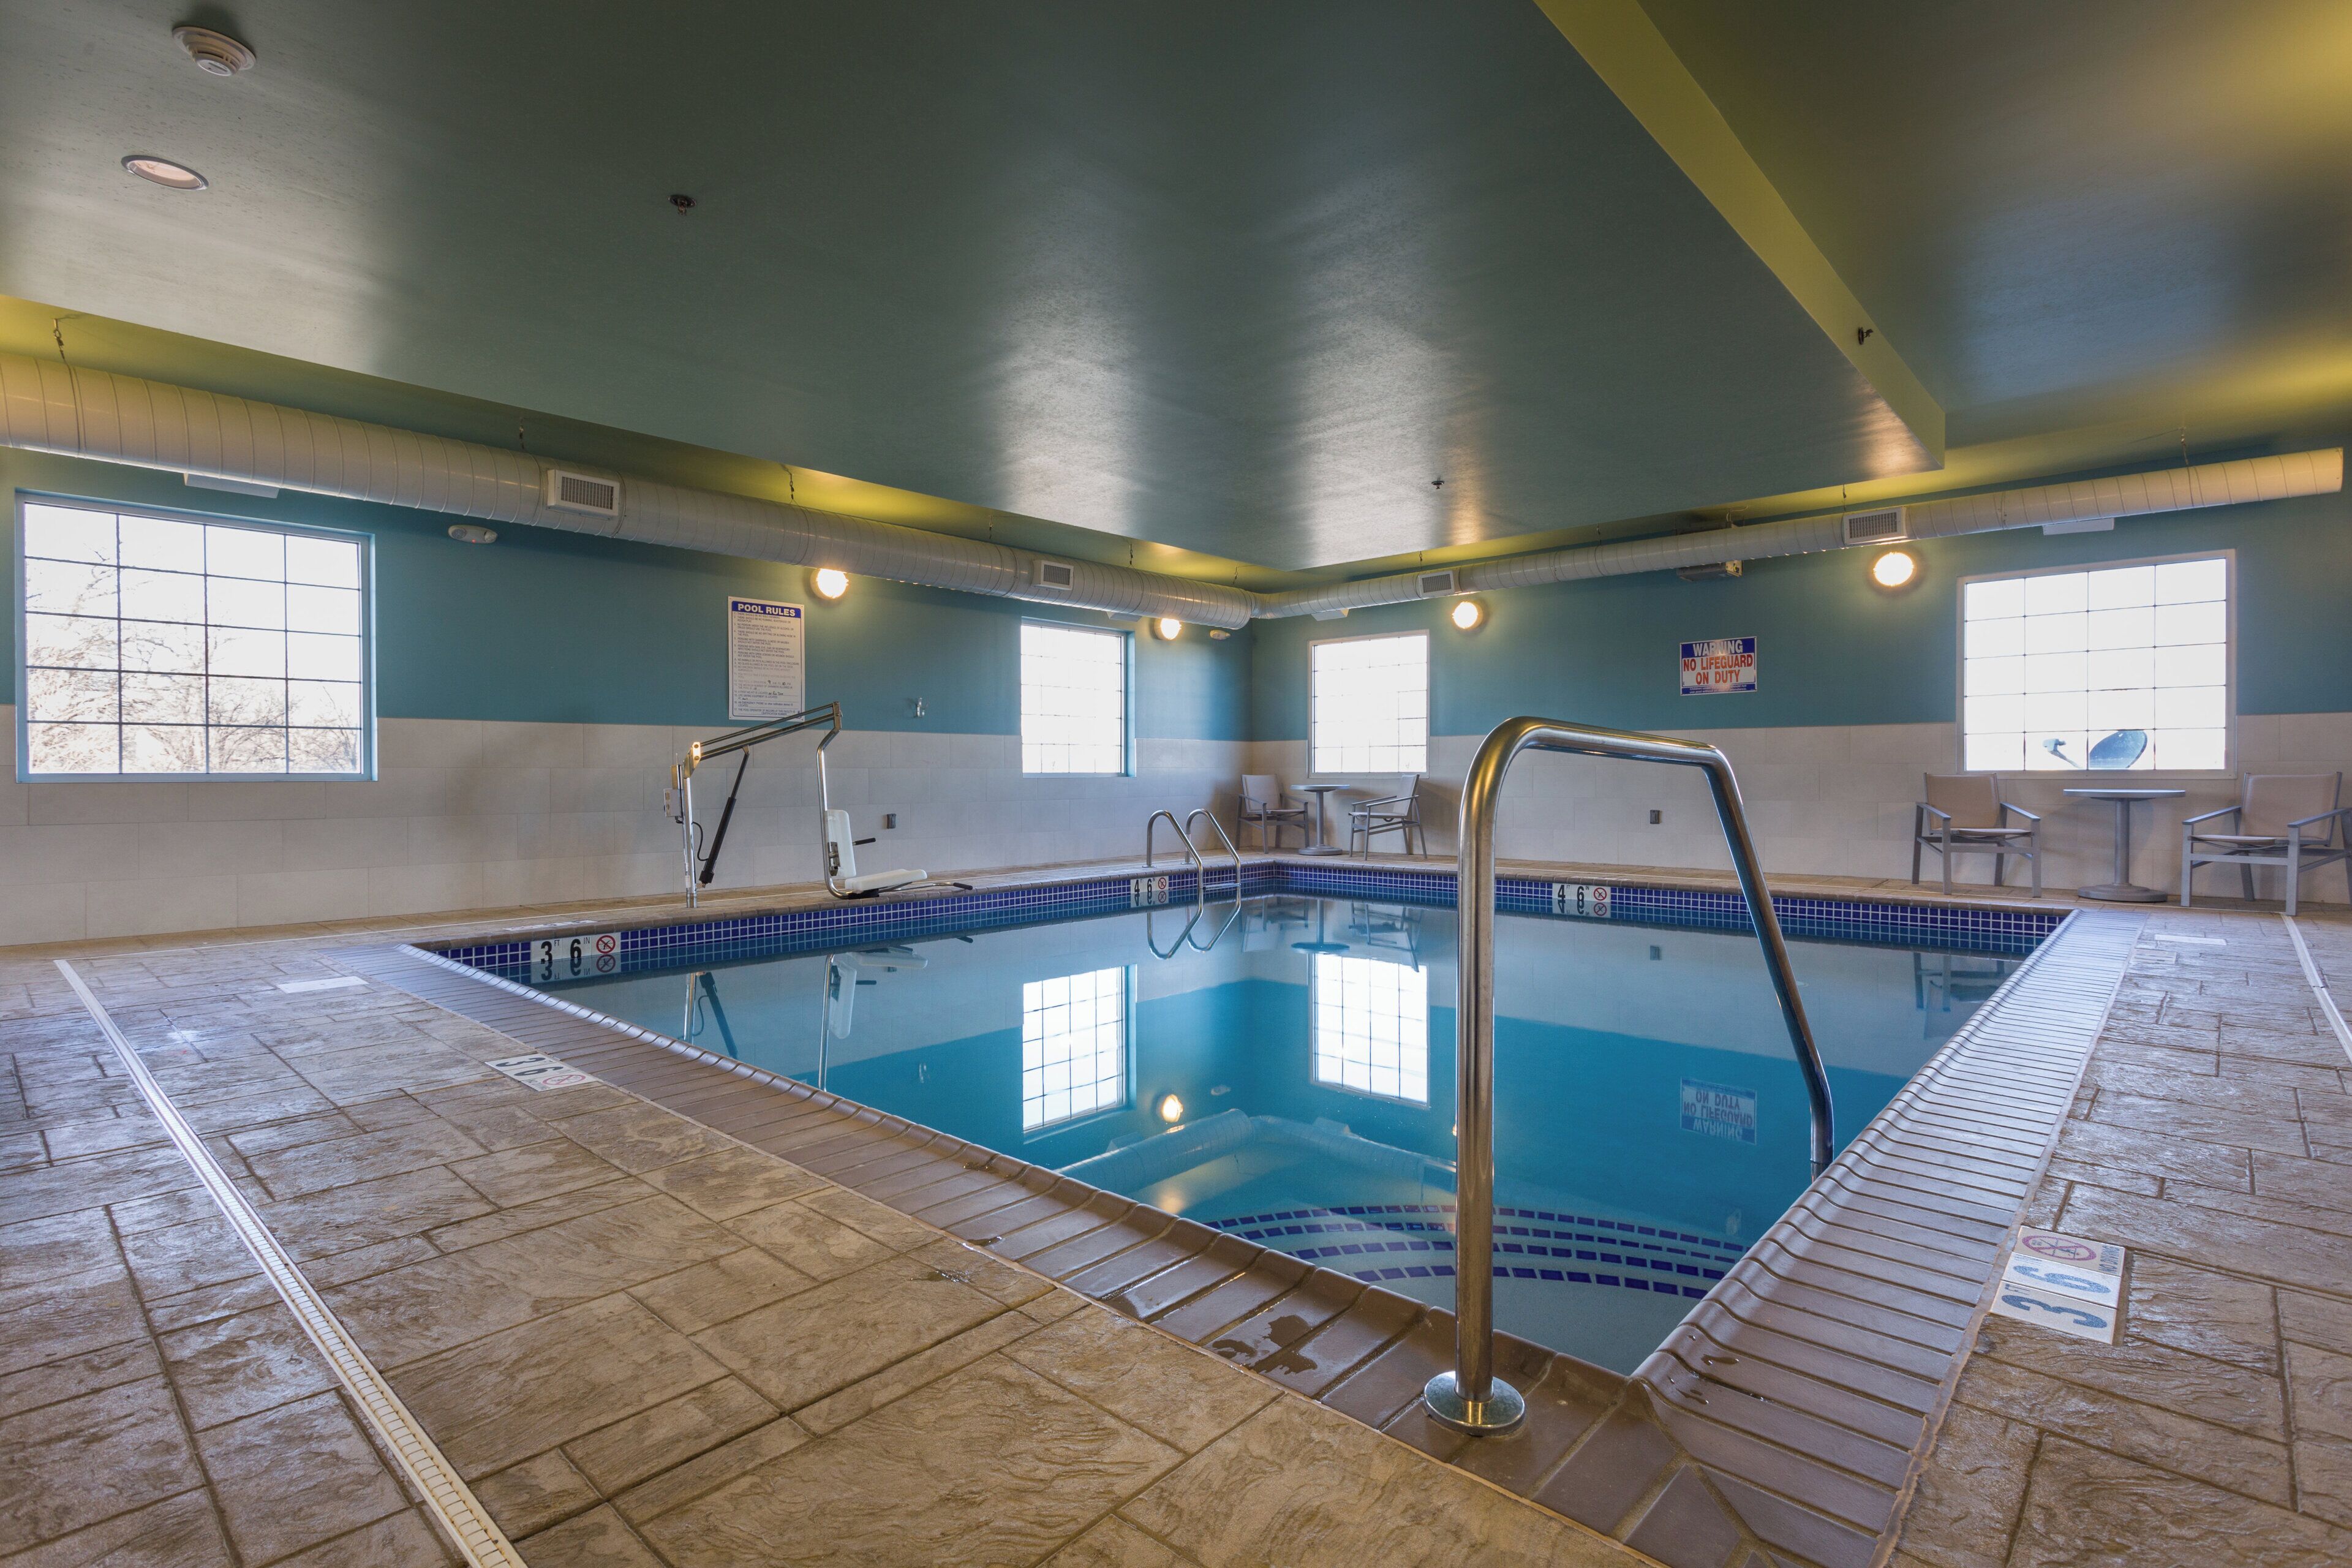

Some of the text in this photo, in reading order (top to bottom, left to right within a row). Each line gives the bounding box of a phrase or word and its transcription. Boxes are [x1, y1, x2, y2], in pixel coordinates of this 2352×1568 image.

[737, 603, 763, 613] POOL
[766, 606, 796, 617] RULES
[1693, 639, 1743, 657] WARNING
[1683, 654, 1753, 672] NO LIFEGUARD
[1695, 669, 1740, 685] ON DUTY
[1134, 880, 1140, 893] 4
[1147, 878, 1152, 892] 6
[1558, 884, 1566, 899] 4
[1577, 886, 1585, 901] 6
[541, 941, 552, 964] 3
[570, 938, 581, 959] 6
[496, 1057, 546, 1067] 3
[514, 1066, 564, 1076] 6
[2098, 1245, 2120, 1274] NO DIVING
[2013, 1265, 2111, 1294] 6
[2001, 1294, 2108, 1328] 3
